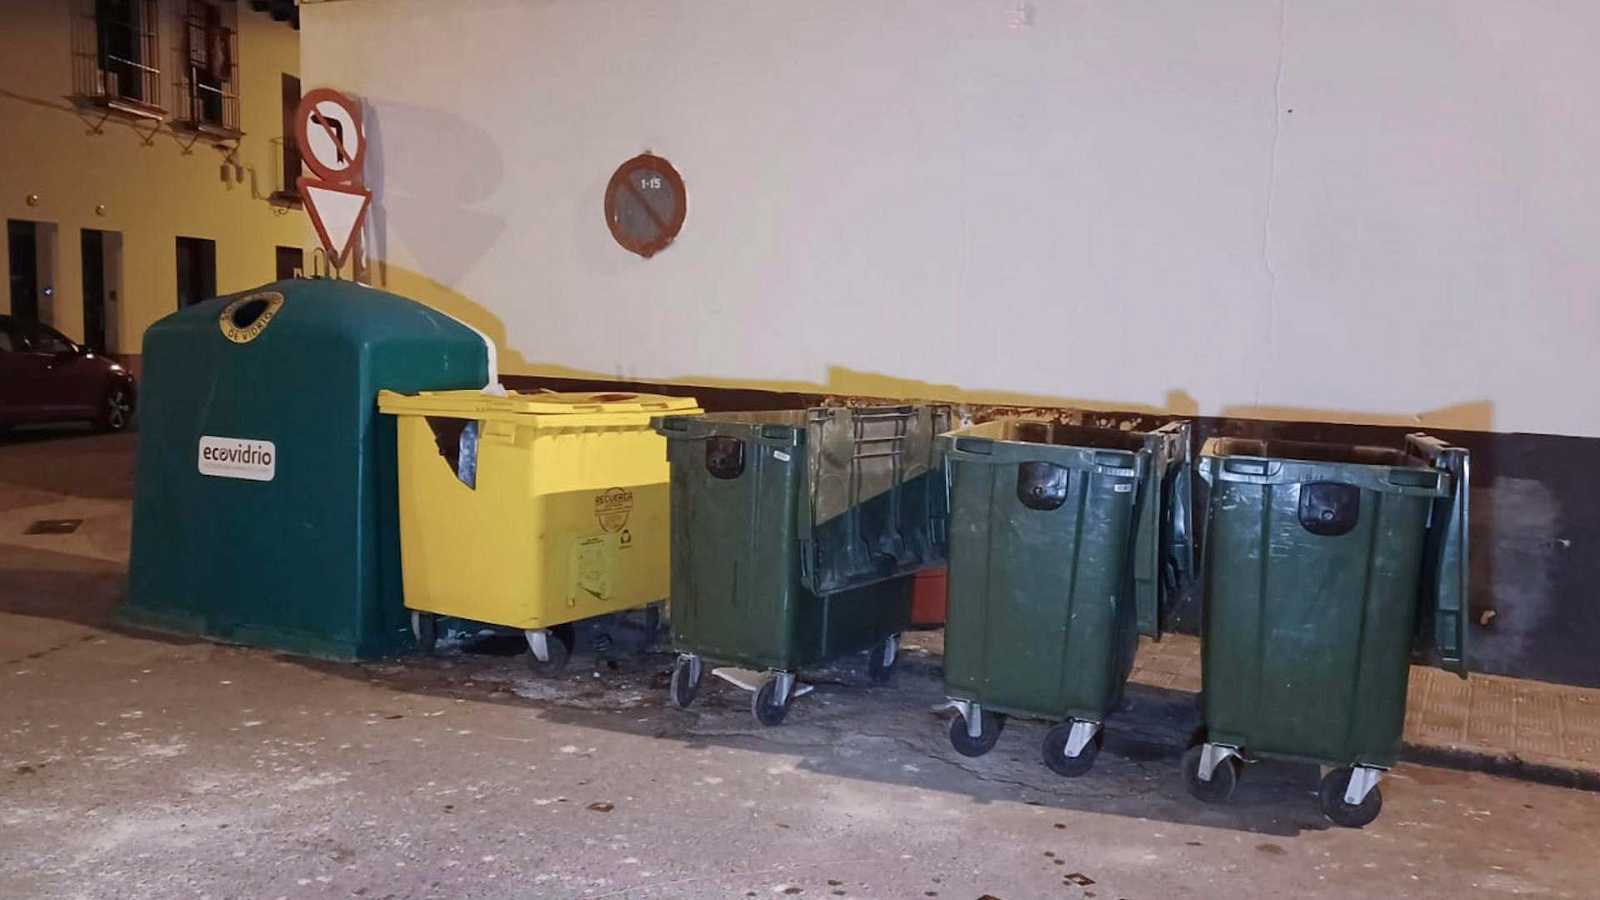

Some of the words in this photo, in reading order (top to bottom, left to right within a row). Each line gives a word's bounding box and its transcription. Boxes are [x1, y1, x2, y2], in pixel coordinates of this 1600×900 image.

[641, 178, 662, 189] 1-15
[228, 330, 241, 341] DE
[242, 311, 273, 340] VIDRIO
[203, 444, 272, 466] ecovidrio
